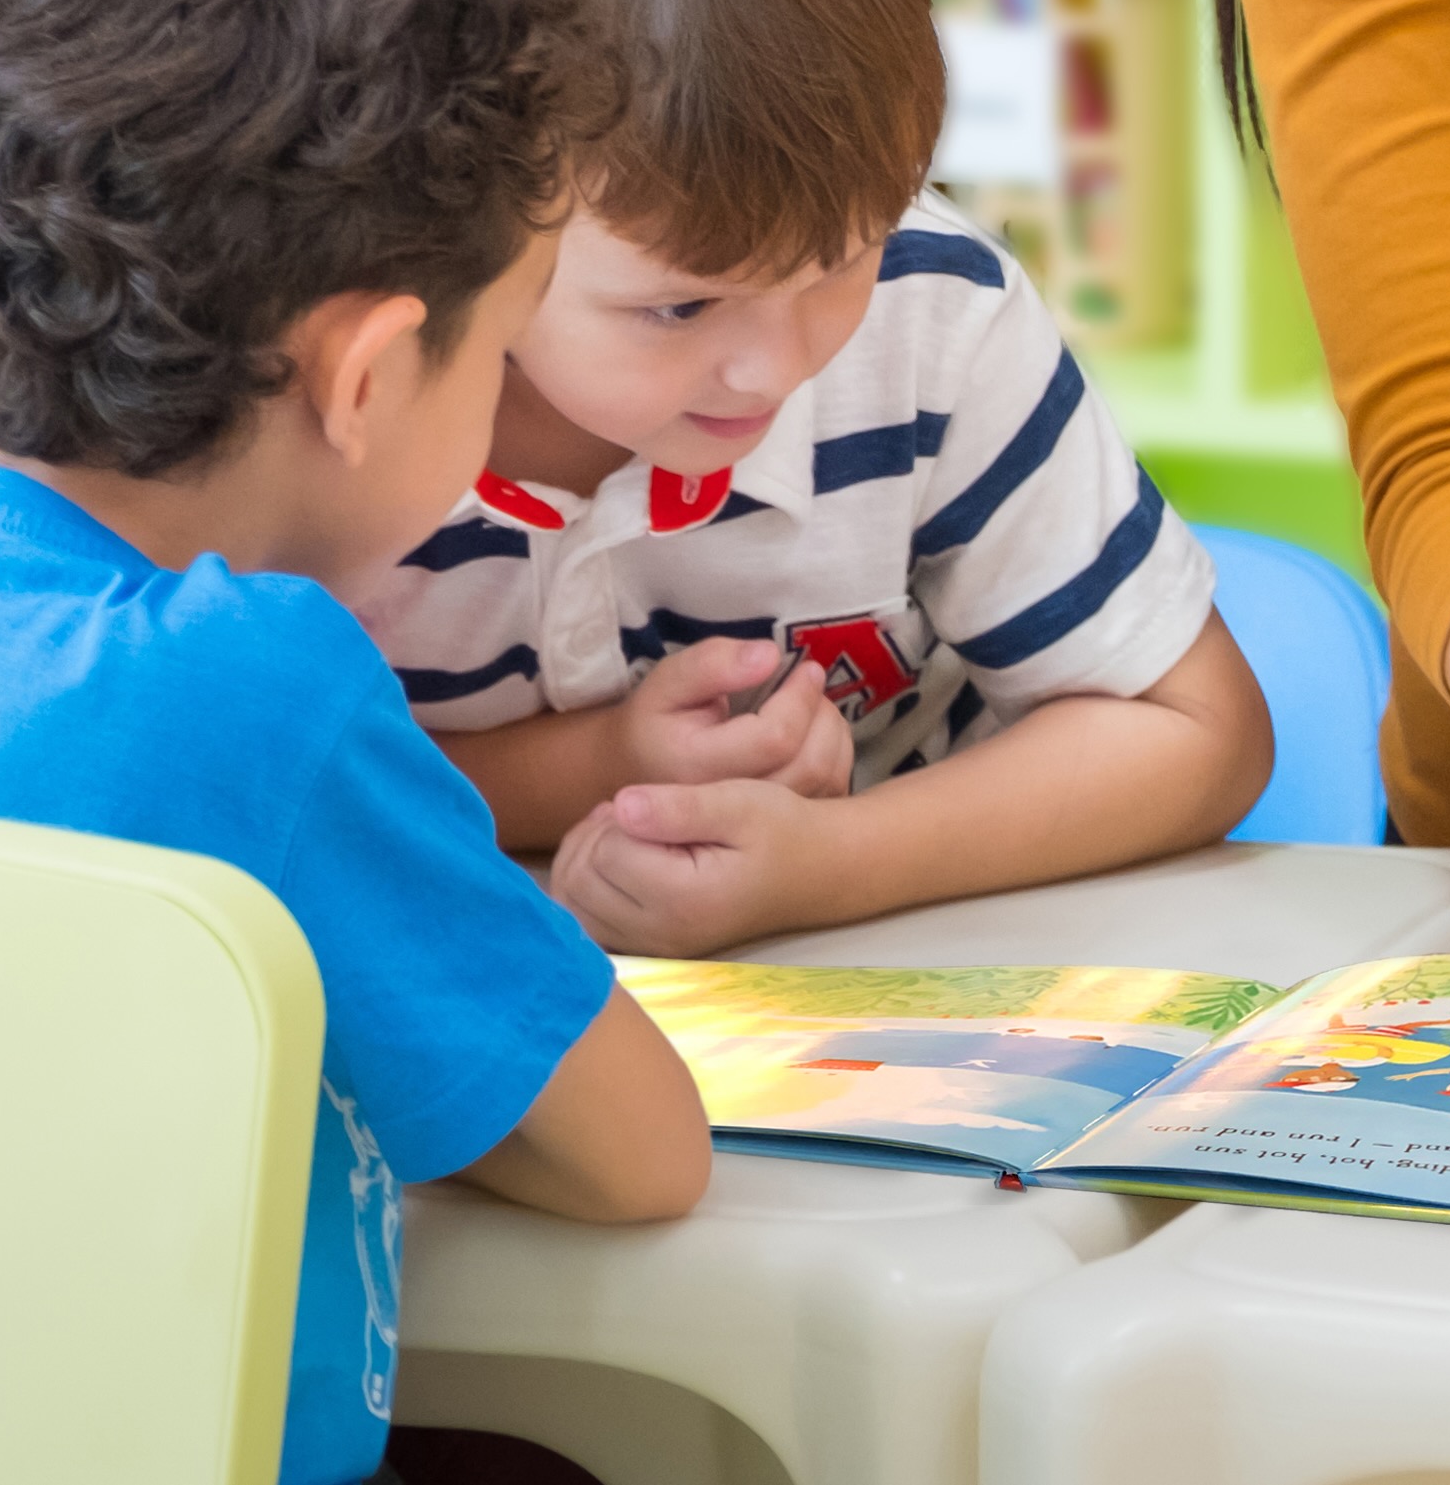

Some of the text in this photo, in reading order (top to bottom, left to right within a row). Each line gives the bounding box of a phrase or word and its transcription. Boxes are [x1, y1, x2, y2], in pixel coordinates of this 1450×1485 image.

[1216, 1127, 1275, 1137] and
[1289, 1133, 1340, 1142] run
[1350, 1138, 1361, 1148] I
[1194, 1145, 1247, 1155] sun
[1257, 1150, 1307, 1163] hot
